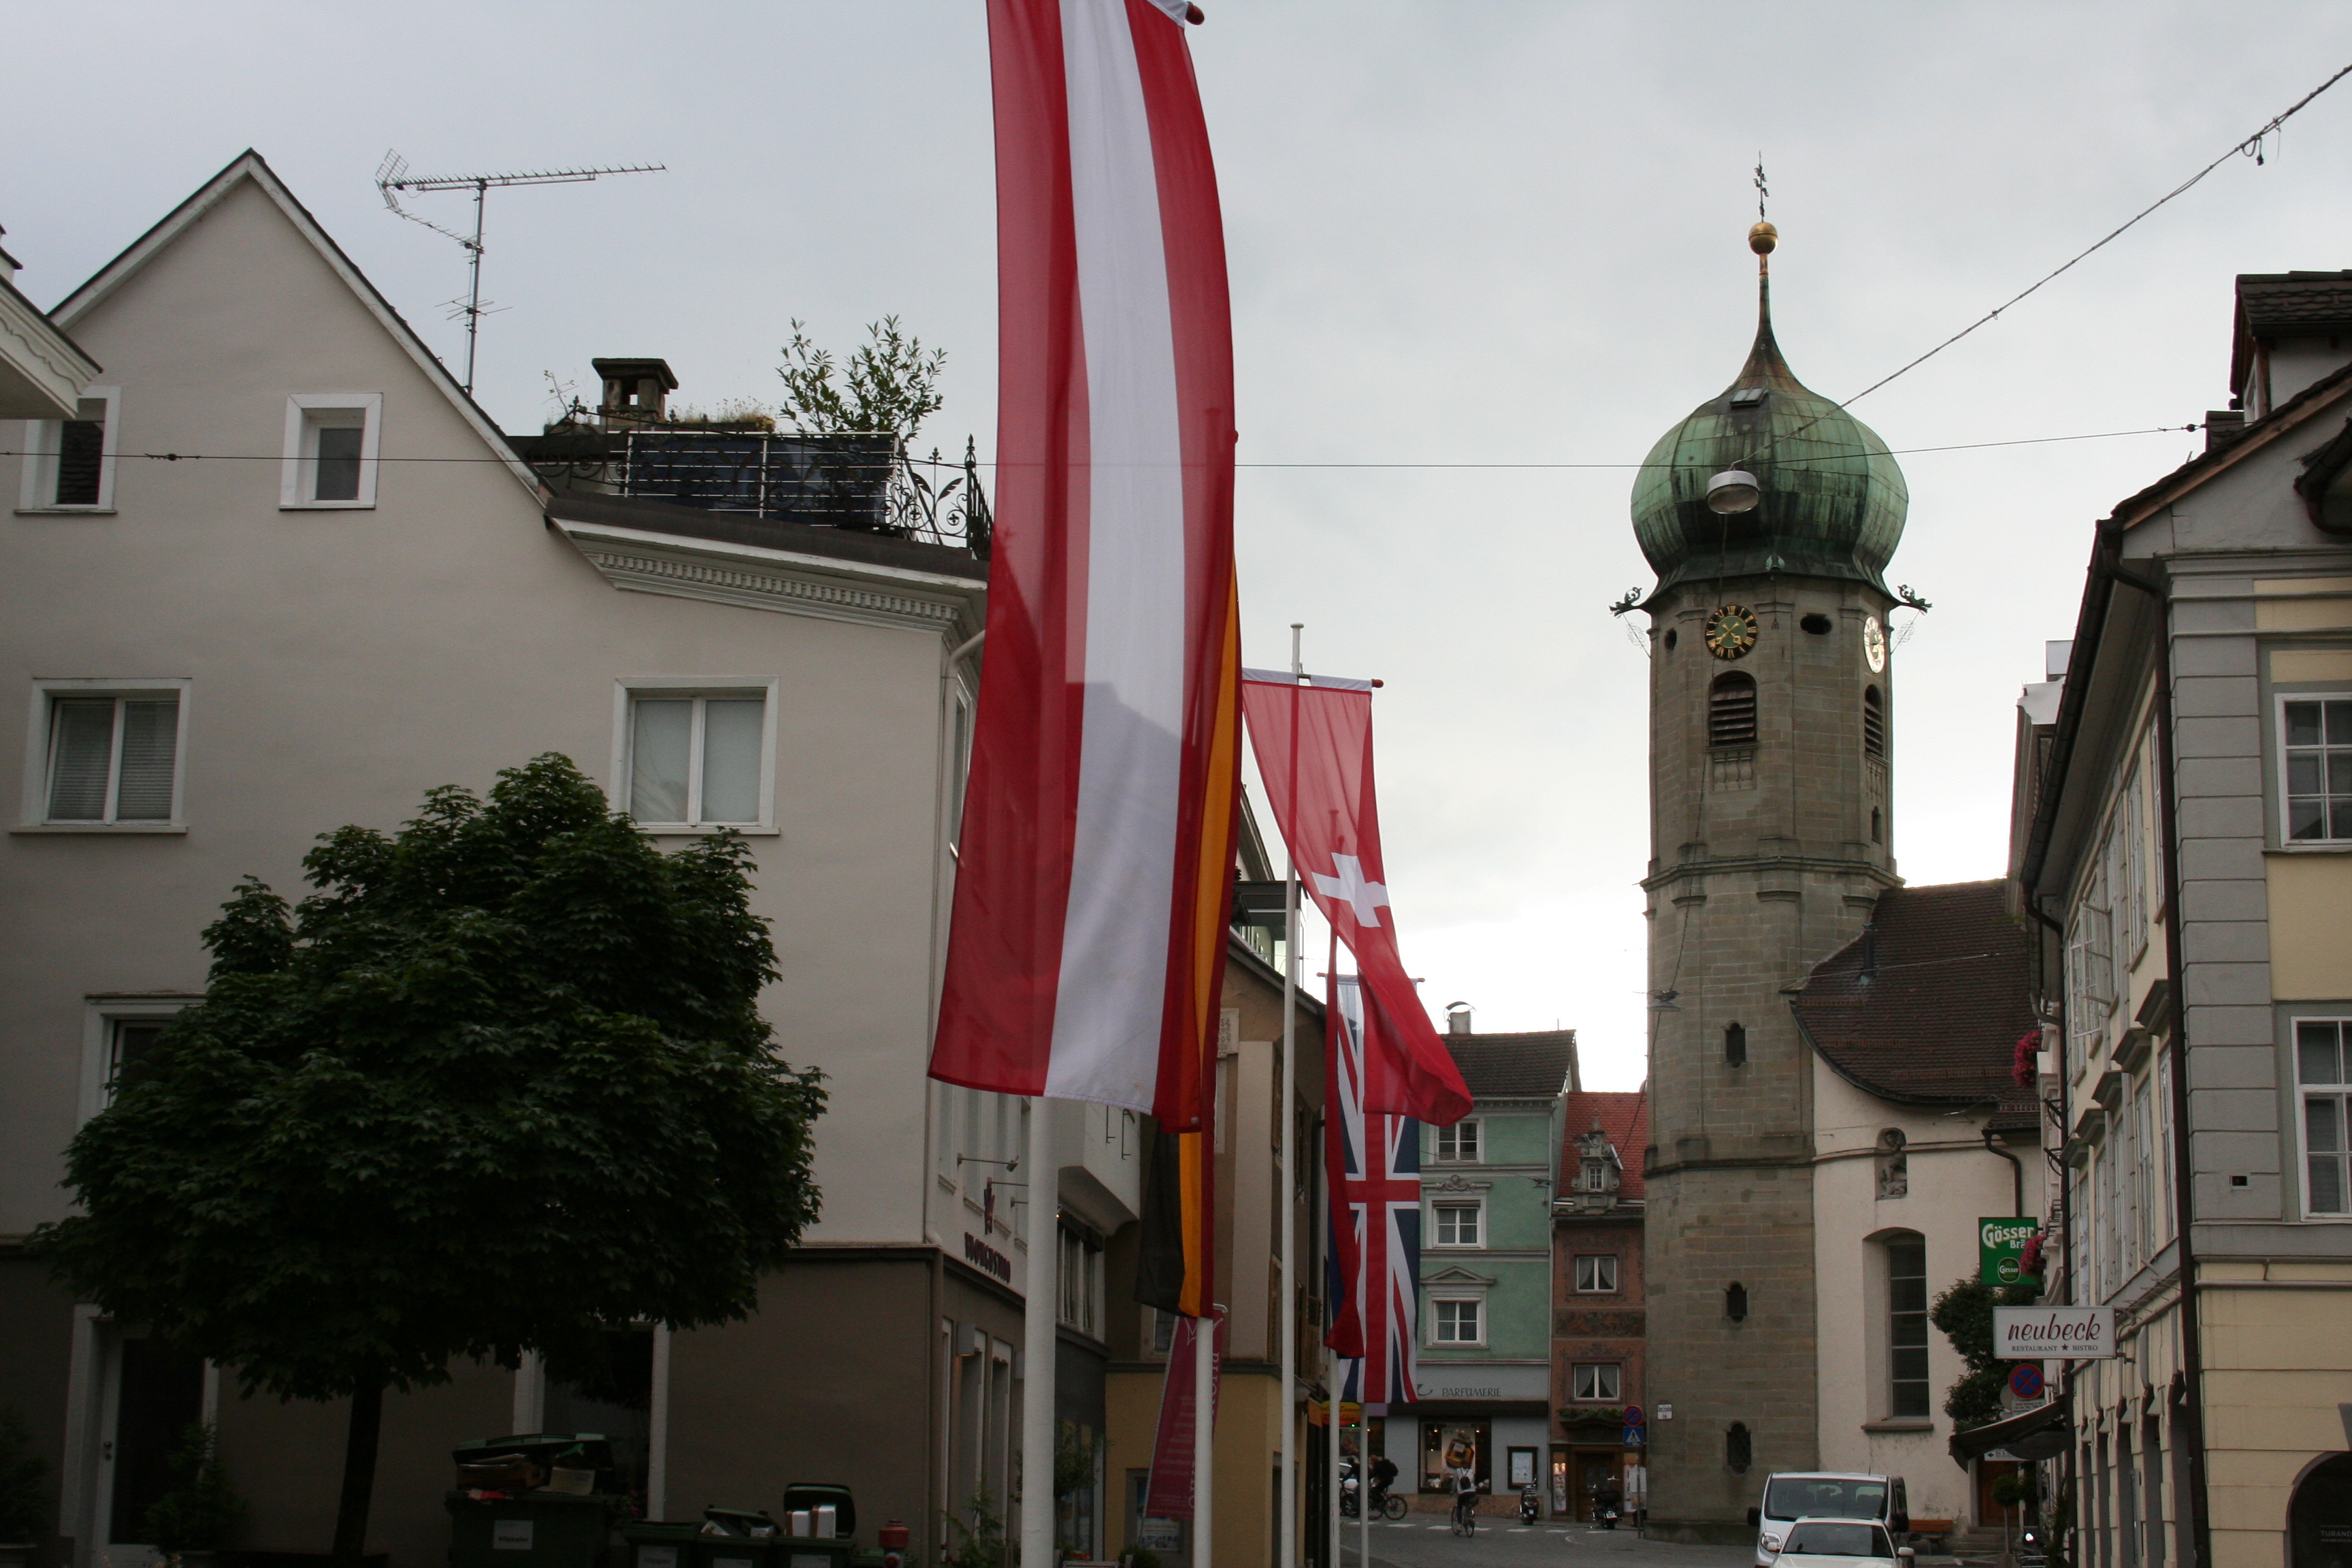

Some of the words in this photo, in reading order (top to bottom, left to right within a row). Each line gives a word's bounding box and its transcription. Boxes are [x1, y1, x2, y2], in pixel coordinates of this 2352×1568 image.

[1982, 1223, 2035, 1249] Gösser
[2009, 1239, 2026, 1250] Brä
[2008, 1313, 2101, 1341] neubeck
